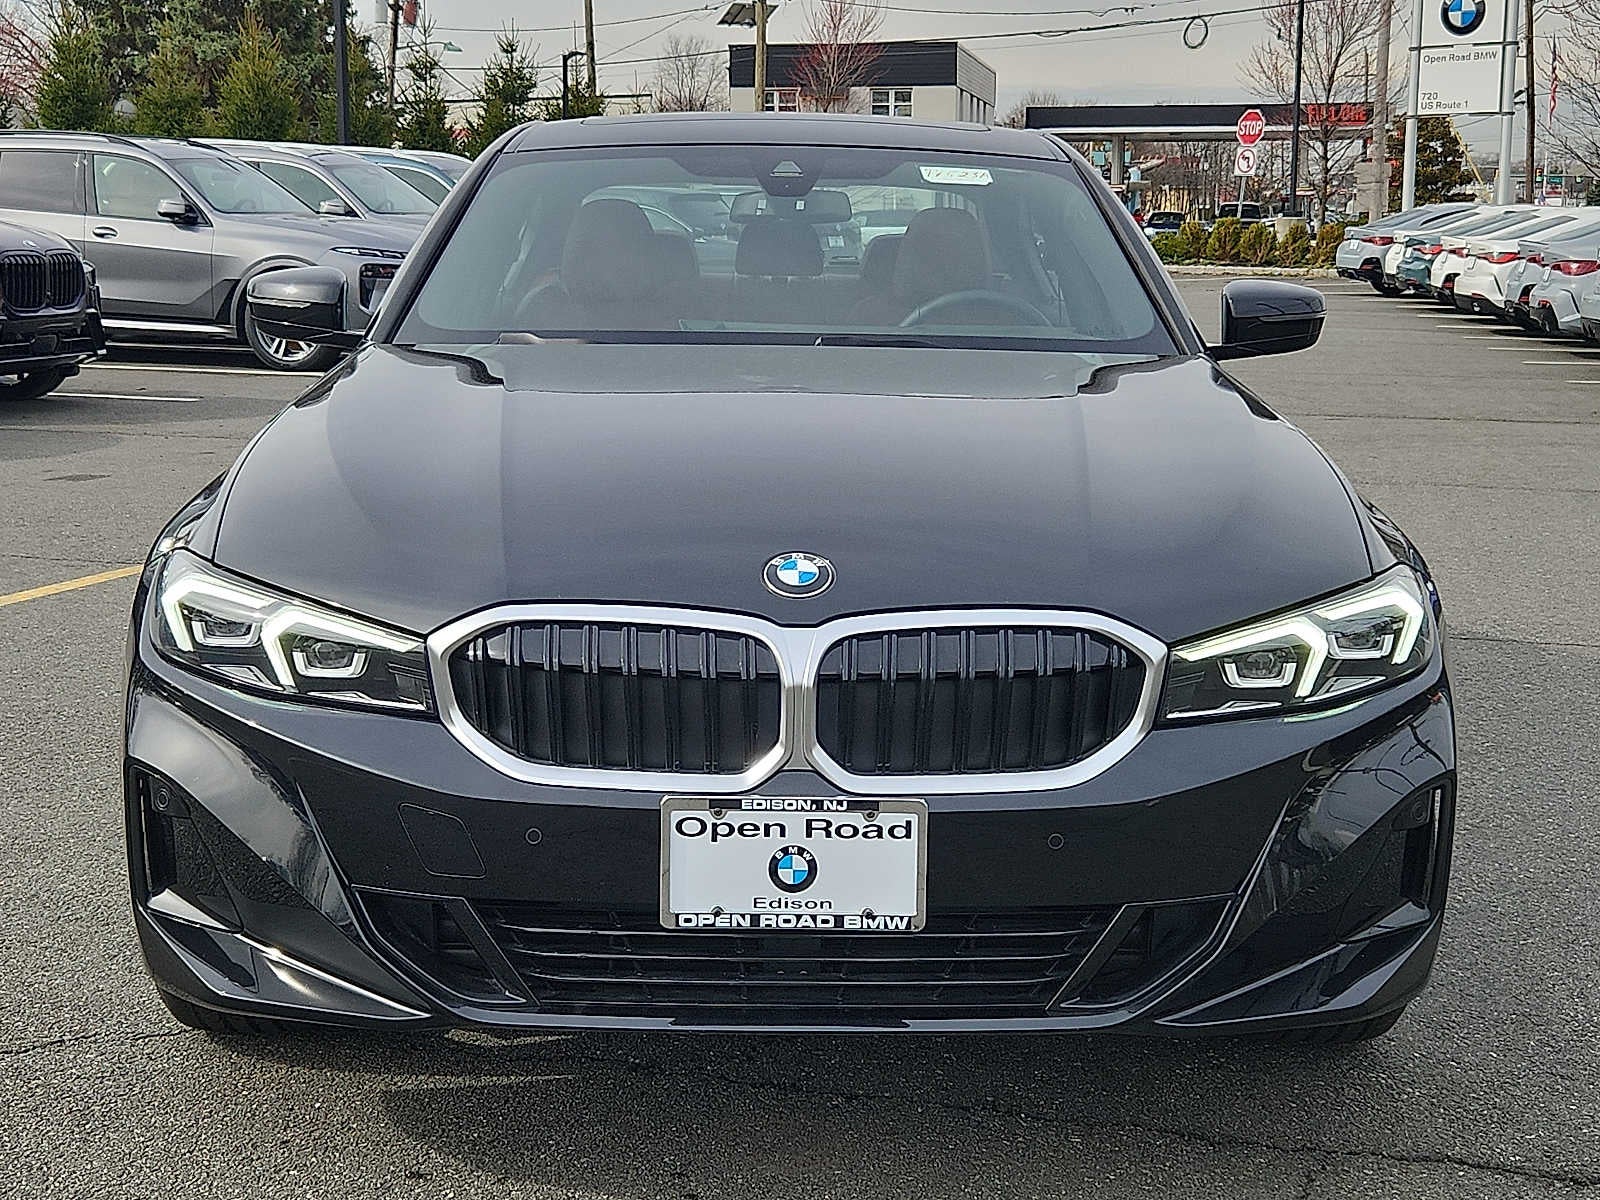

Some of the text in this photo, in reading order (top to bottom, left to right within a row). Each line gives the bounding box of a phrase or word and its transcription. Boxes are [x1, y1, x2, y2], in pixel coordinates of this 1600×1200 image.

[1423, 51, 1498, 64] Open Road BMW
[1421, 92, 1439, 100] 720
[1421, 102, 1434, 110] US
[1435, 101, 1461, 109] Route
[1239, 120, 1262, 135] STOP
[741, 799, 848, 811] EDISON, NJ
[675, 816, 912, 843] Open Road
[774, 846, 813, 861] BMW
[753, 897, 833, 910] Edison
[678, 914, 910, 930] OPEN ROAD BMW
